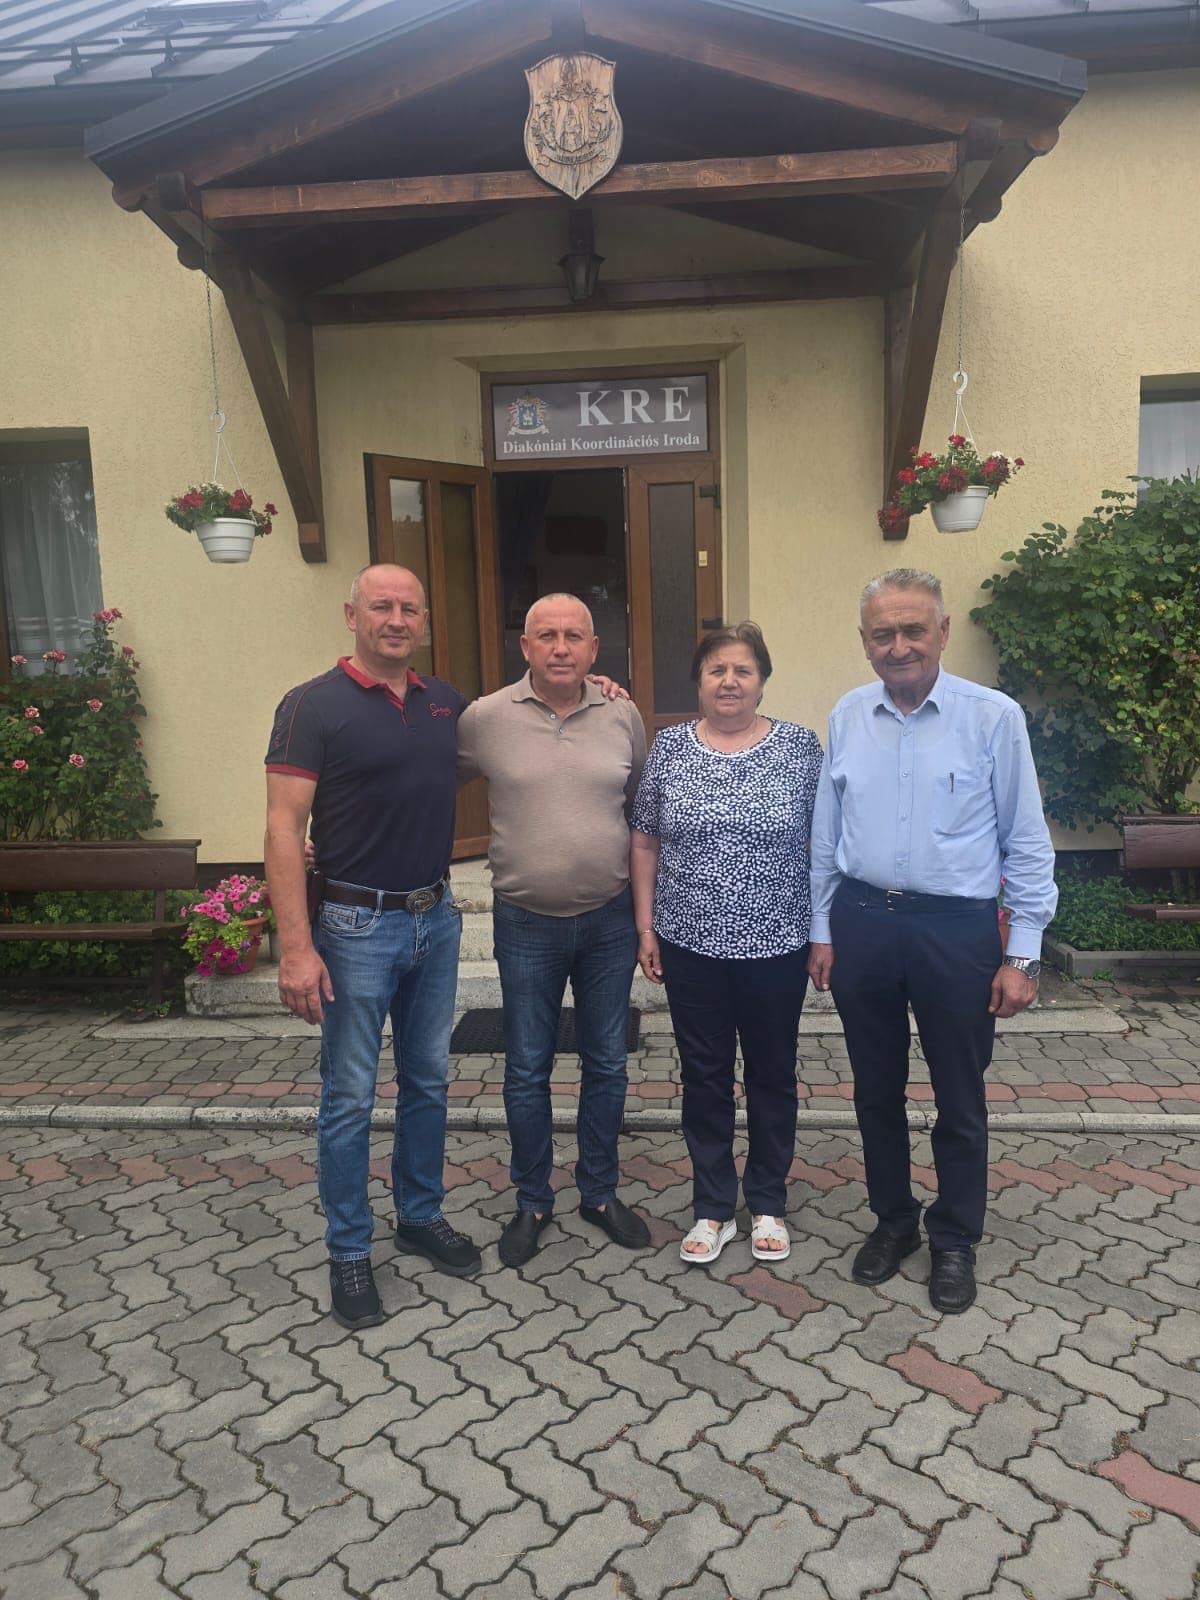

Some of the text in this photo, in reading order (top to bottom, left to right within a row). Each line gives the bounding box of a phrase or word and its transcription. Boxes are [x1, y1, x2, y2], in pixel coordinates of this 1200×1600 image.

[576, 386, 692, 427] KRE
[503, 433, 700, 454] Diakóniai Koordinációs Iroda
